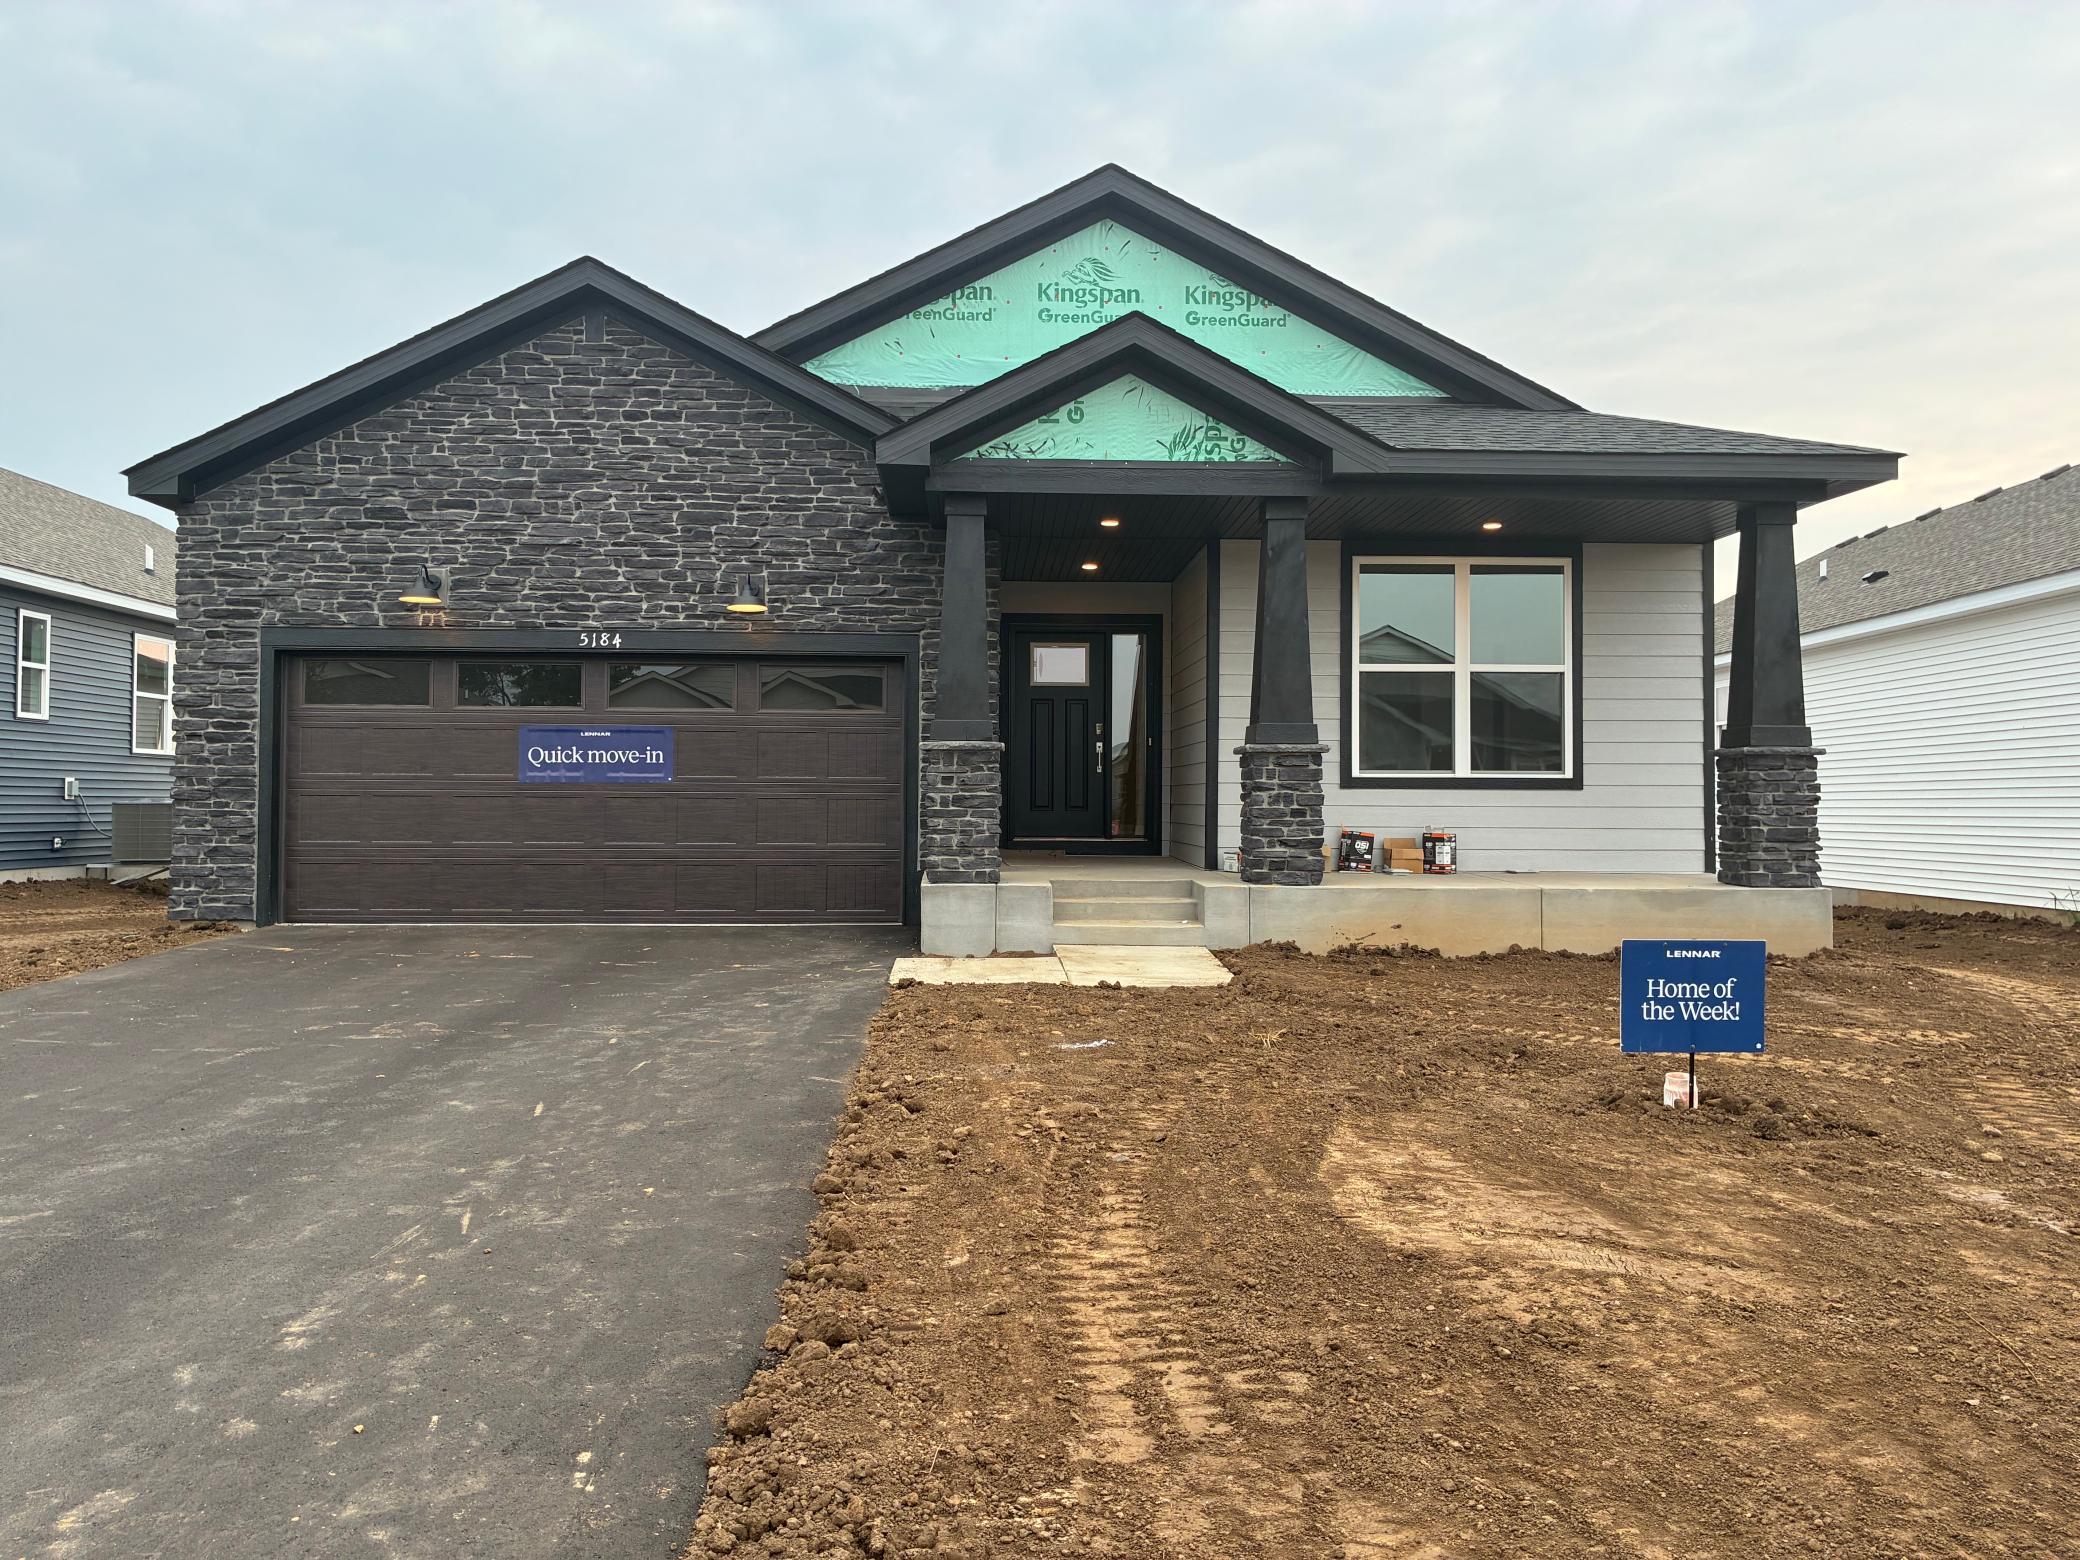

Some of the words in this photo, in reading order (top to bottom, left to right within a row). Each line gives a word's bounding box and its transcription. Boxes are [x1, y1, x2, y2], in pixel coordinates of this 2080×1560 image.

[1037, 281, 1141, 309] Kingspan
[905, 307, 993, 321] reenGuard
[1185, 311, 1287, 327] GreenGuard
[579, 633, 622, 648] 5184
[528, 746, 584, 767] Quick
[588, 746, 664, 764] move-in
[1666, 950, 1721, 958] LENNAR
[1646, 978, 1710, 998] Home
[1713, 978, 1738, 999] of
[1641, 1001, 1675, 1021] the
[1678, 1001, 1740, 1021] Week!
